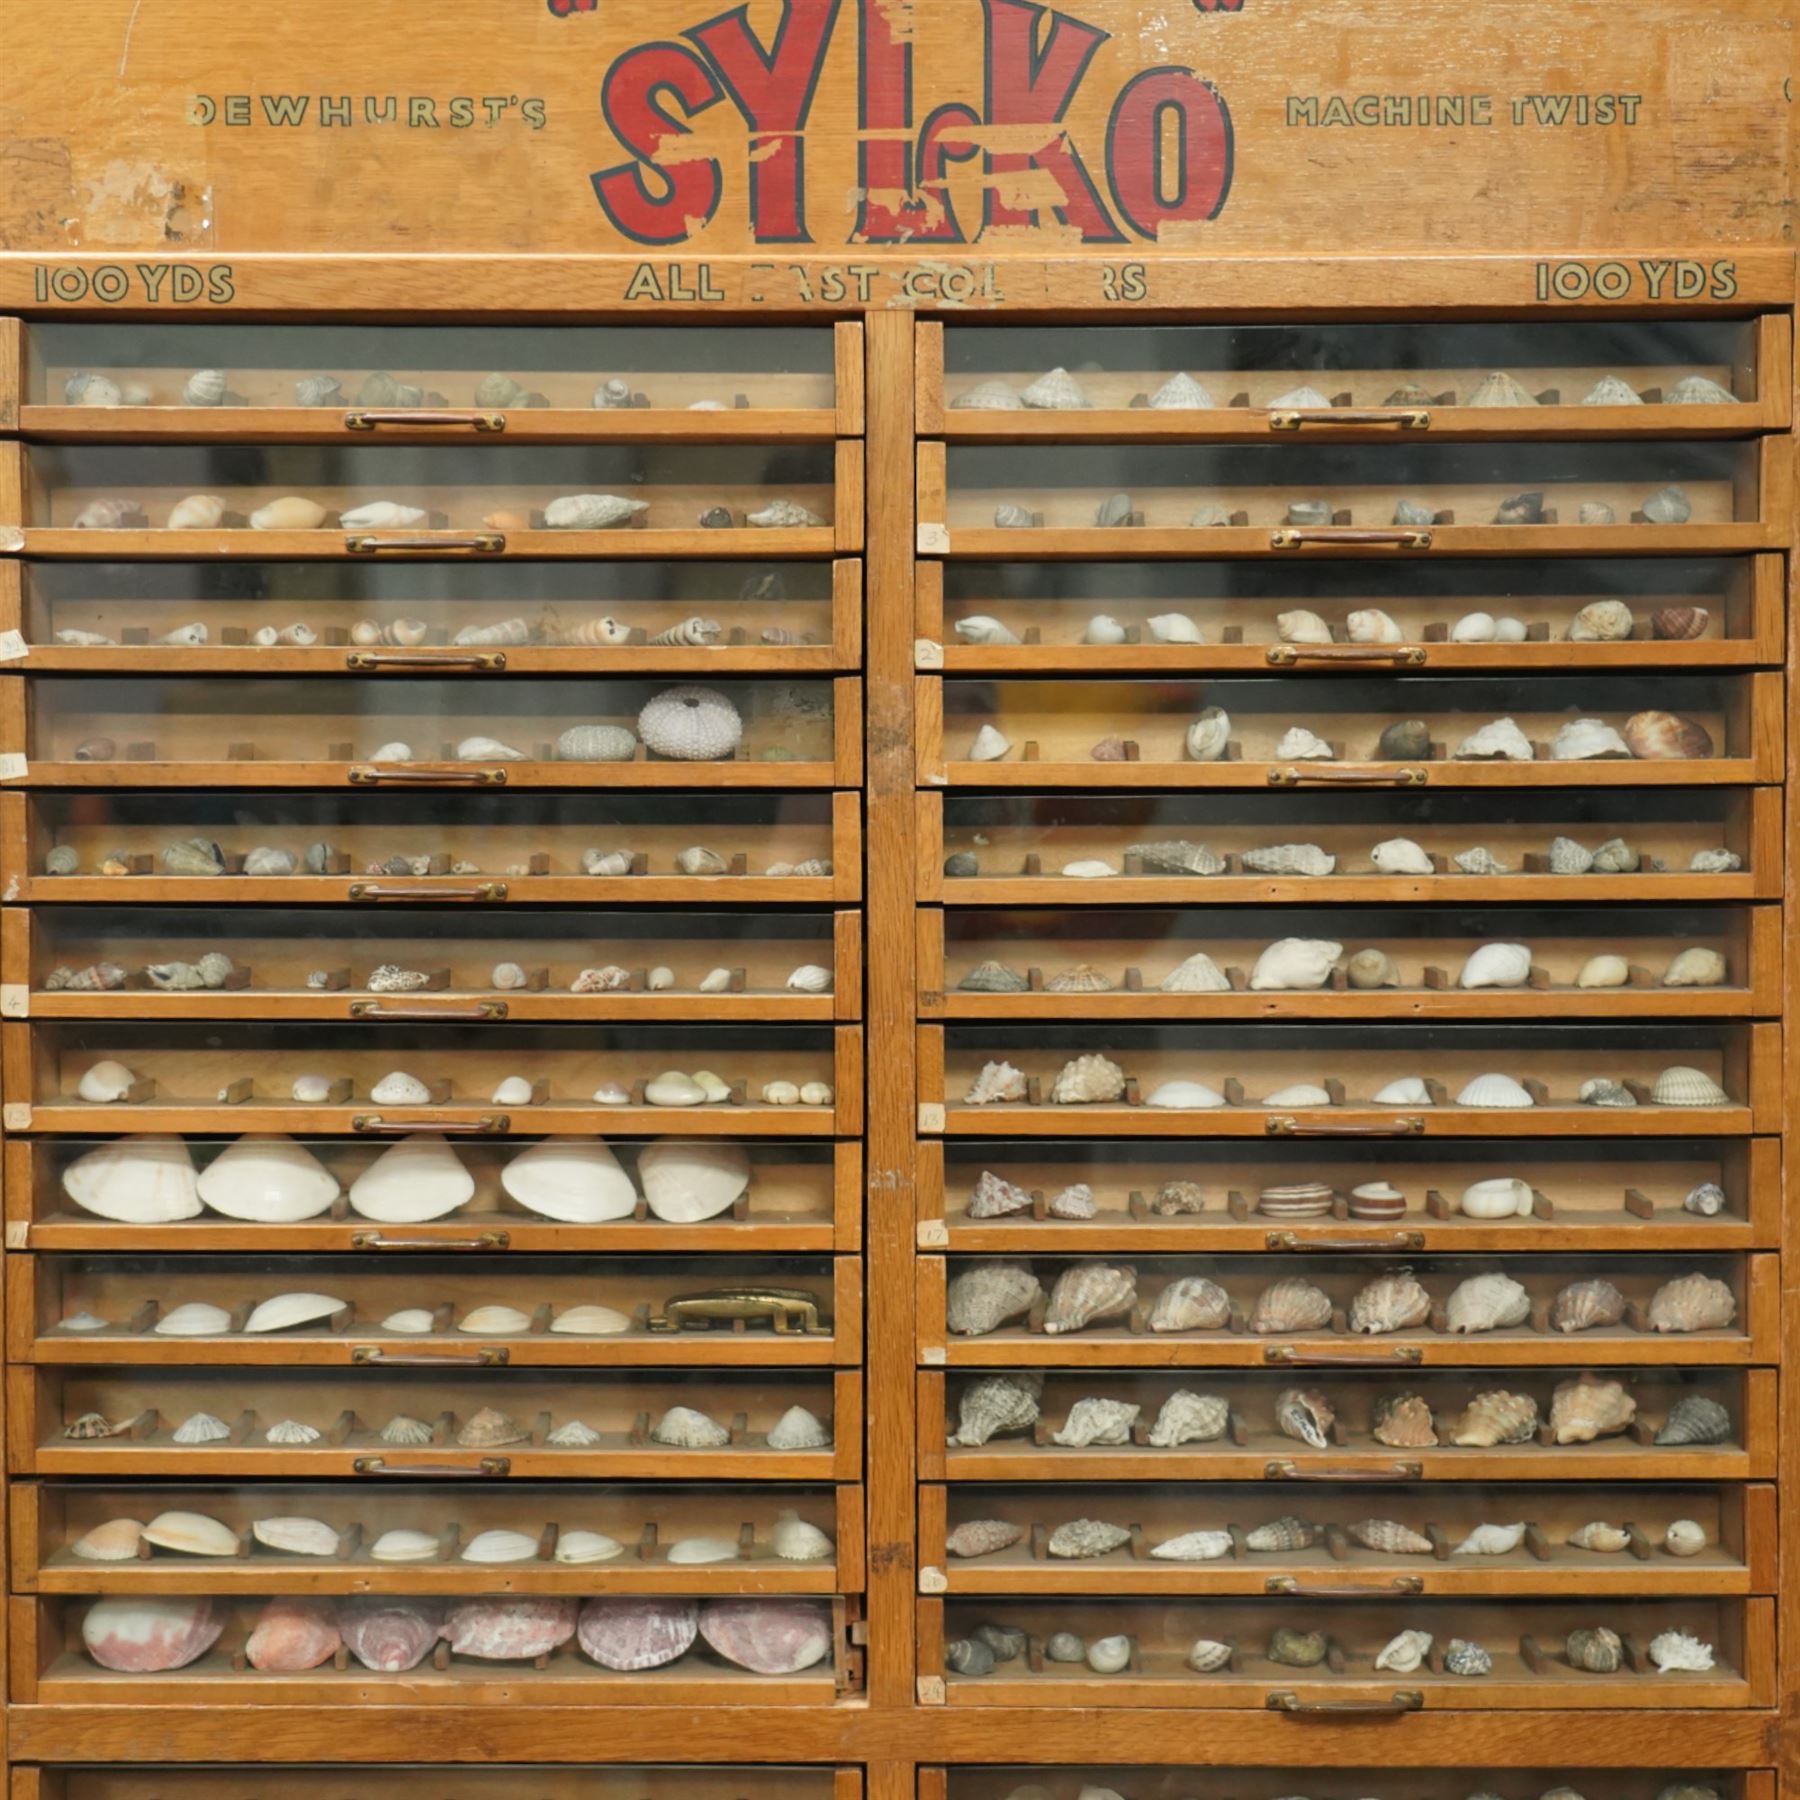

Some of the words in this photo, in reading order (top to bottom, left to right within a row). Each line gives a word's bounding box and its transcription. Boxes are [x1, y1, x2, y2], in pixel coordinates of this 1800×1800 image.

[1285, 94, 1493, 127] MACHINE
[1510, 94, 1642, 127] TWIST
[136, 263, 236, 304] YDS
[623, 263, 725, 301] ALL
[1638, 259, 1738, 300] YDS
